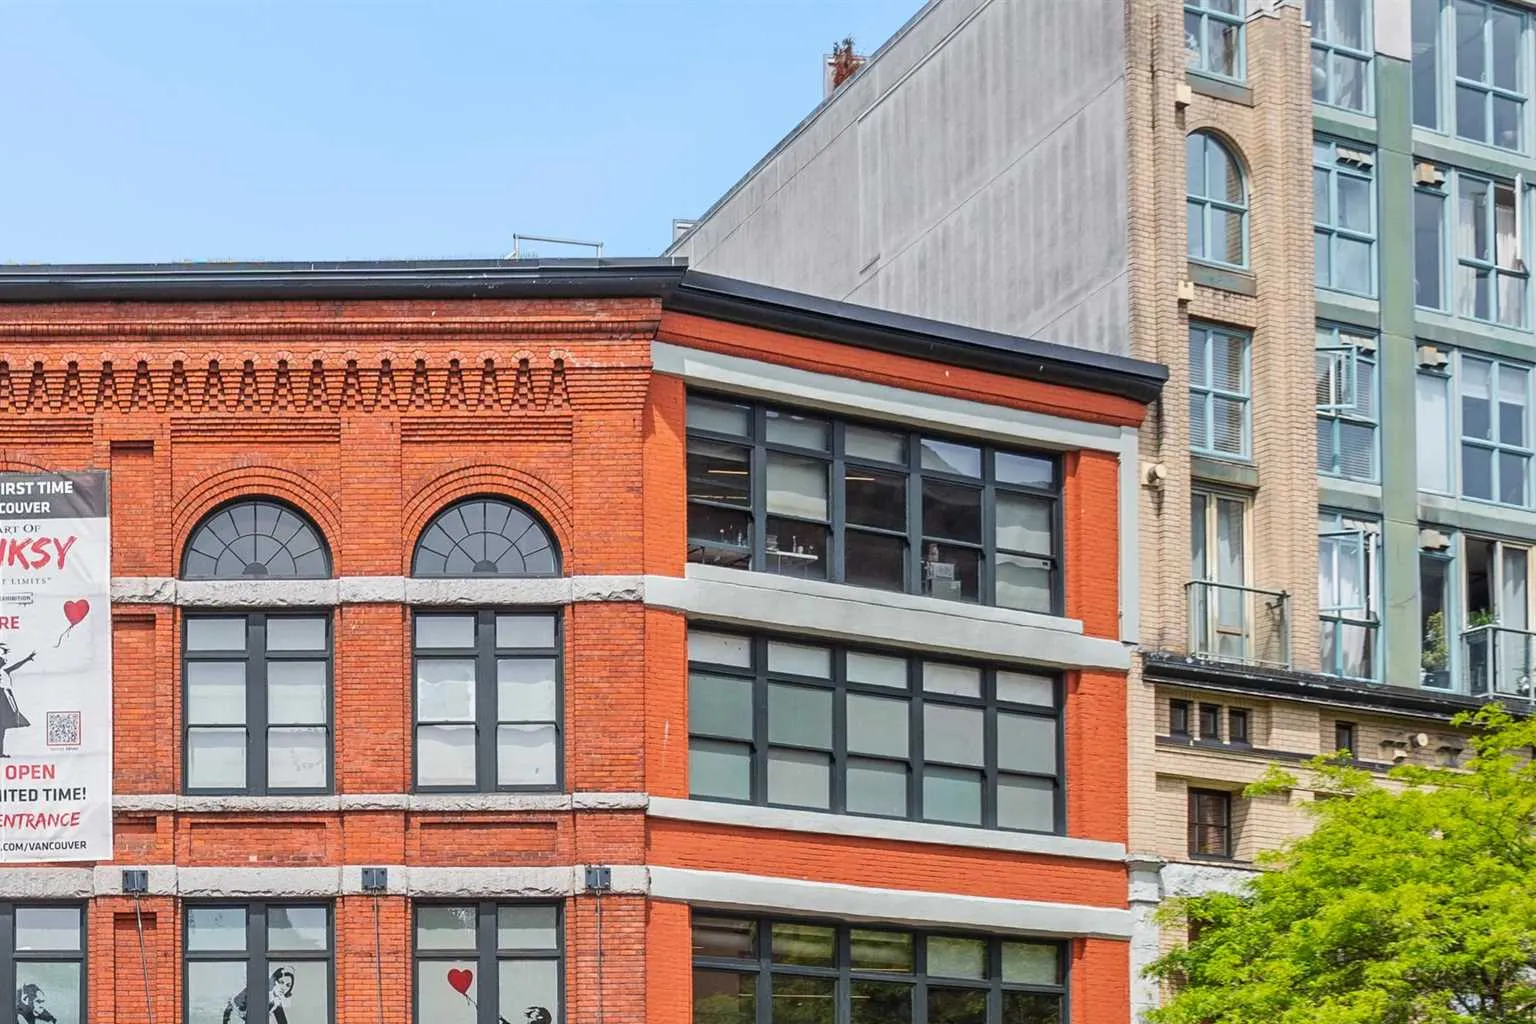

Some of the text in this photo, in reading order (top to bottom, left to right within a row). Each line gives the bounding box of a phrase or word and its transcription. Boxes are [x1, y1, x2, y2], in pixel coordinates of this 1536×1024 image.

[36, 481, 73, 494] TIME
[23, 524, 41, 533] OF
[5, 764, 55, 780] OPEN
[42, 787, 86, 801] TIME!
